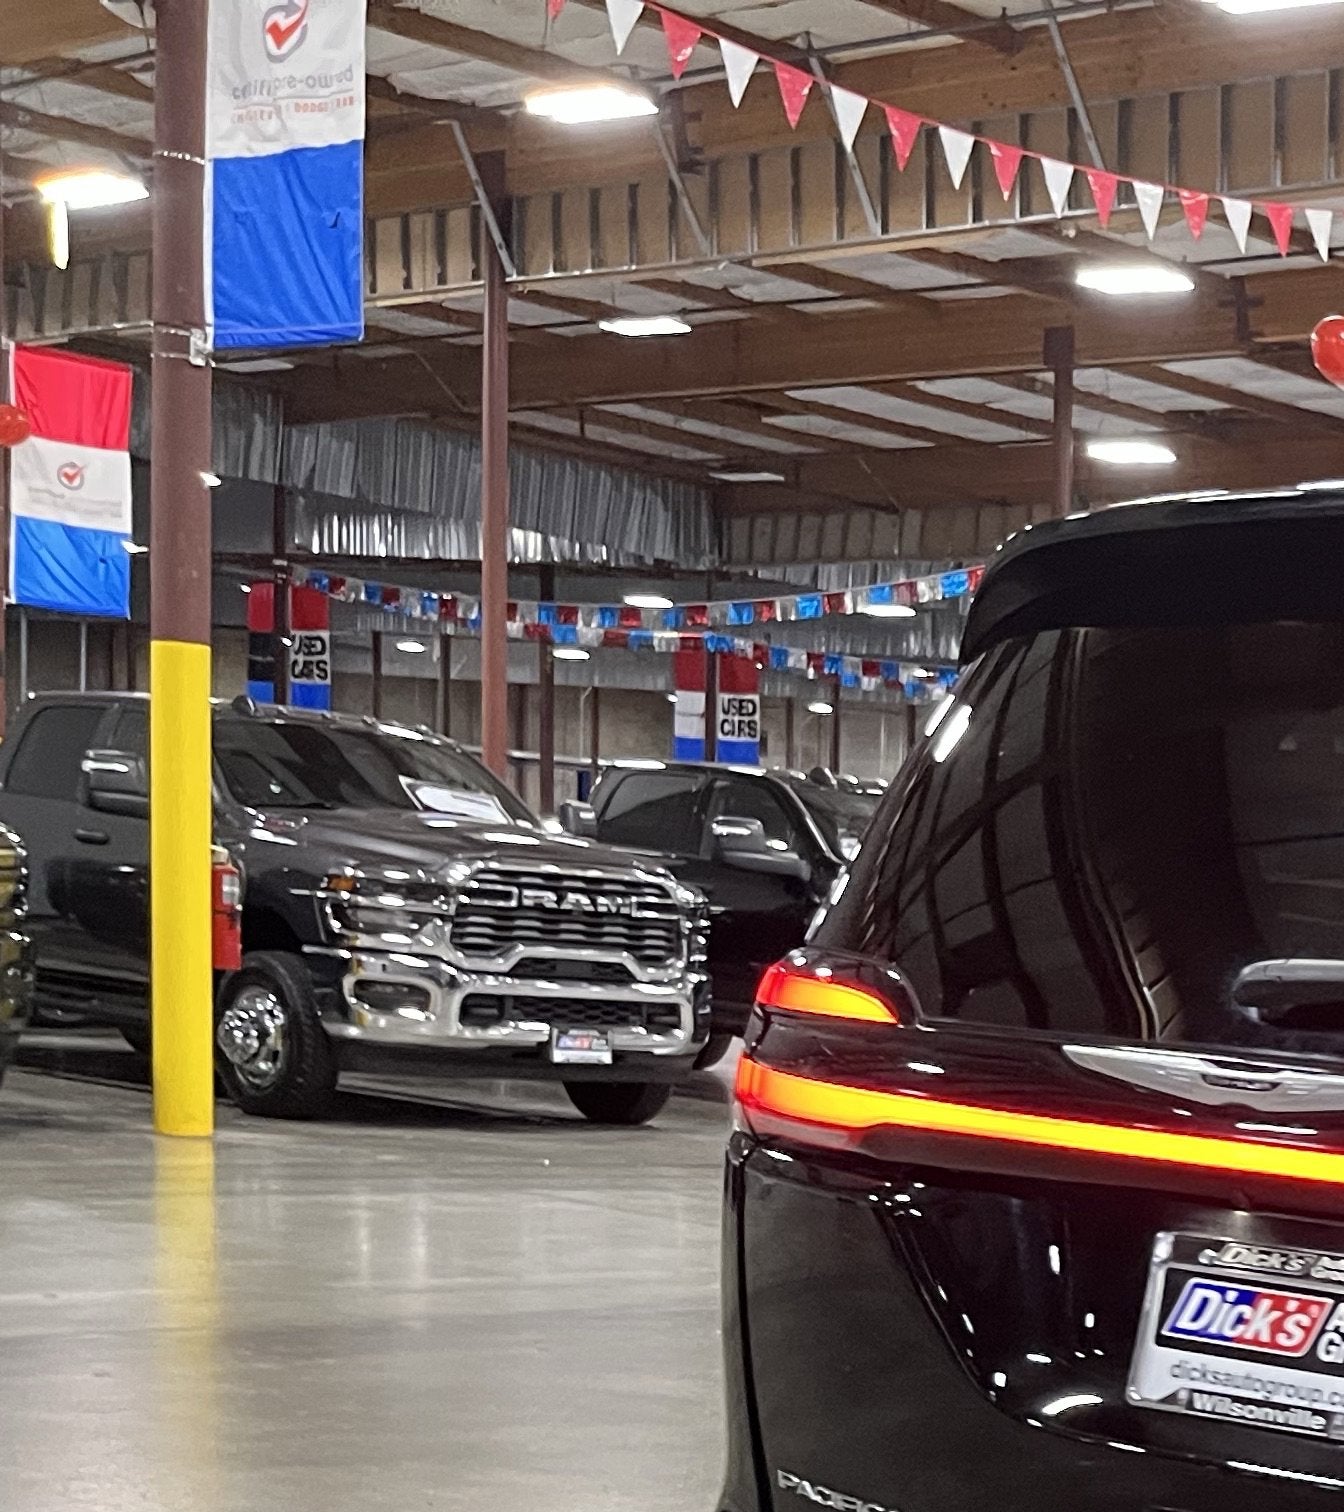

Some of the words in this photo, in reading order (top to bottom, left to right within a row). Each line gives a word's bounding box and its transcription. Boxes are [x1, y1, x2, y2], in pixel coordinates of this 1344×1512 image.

[721, 697, 757, 717] USED
[522, 888, 631, 914] RAM
[1175, 1287, 1313, 1348] Dick's
[1191, 1391, 1327, 1430] Wilsonville
